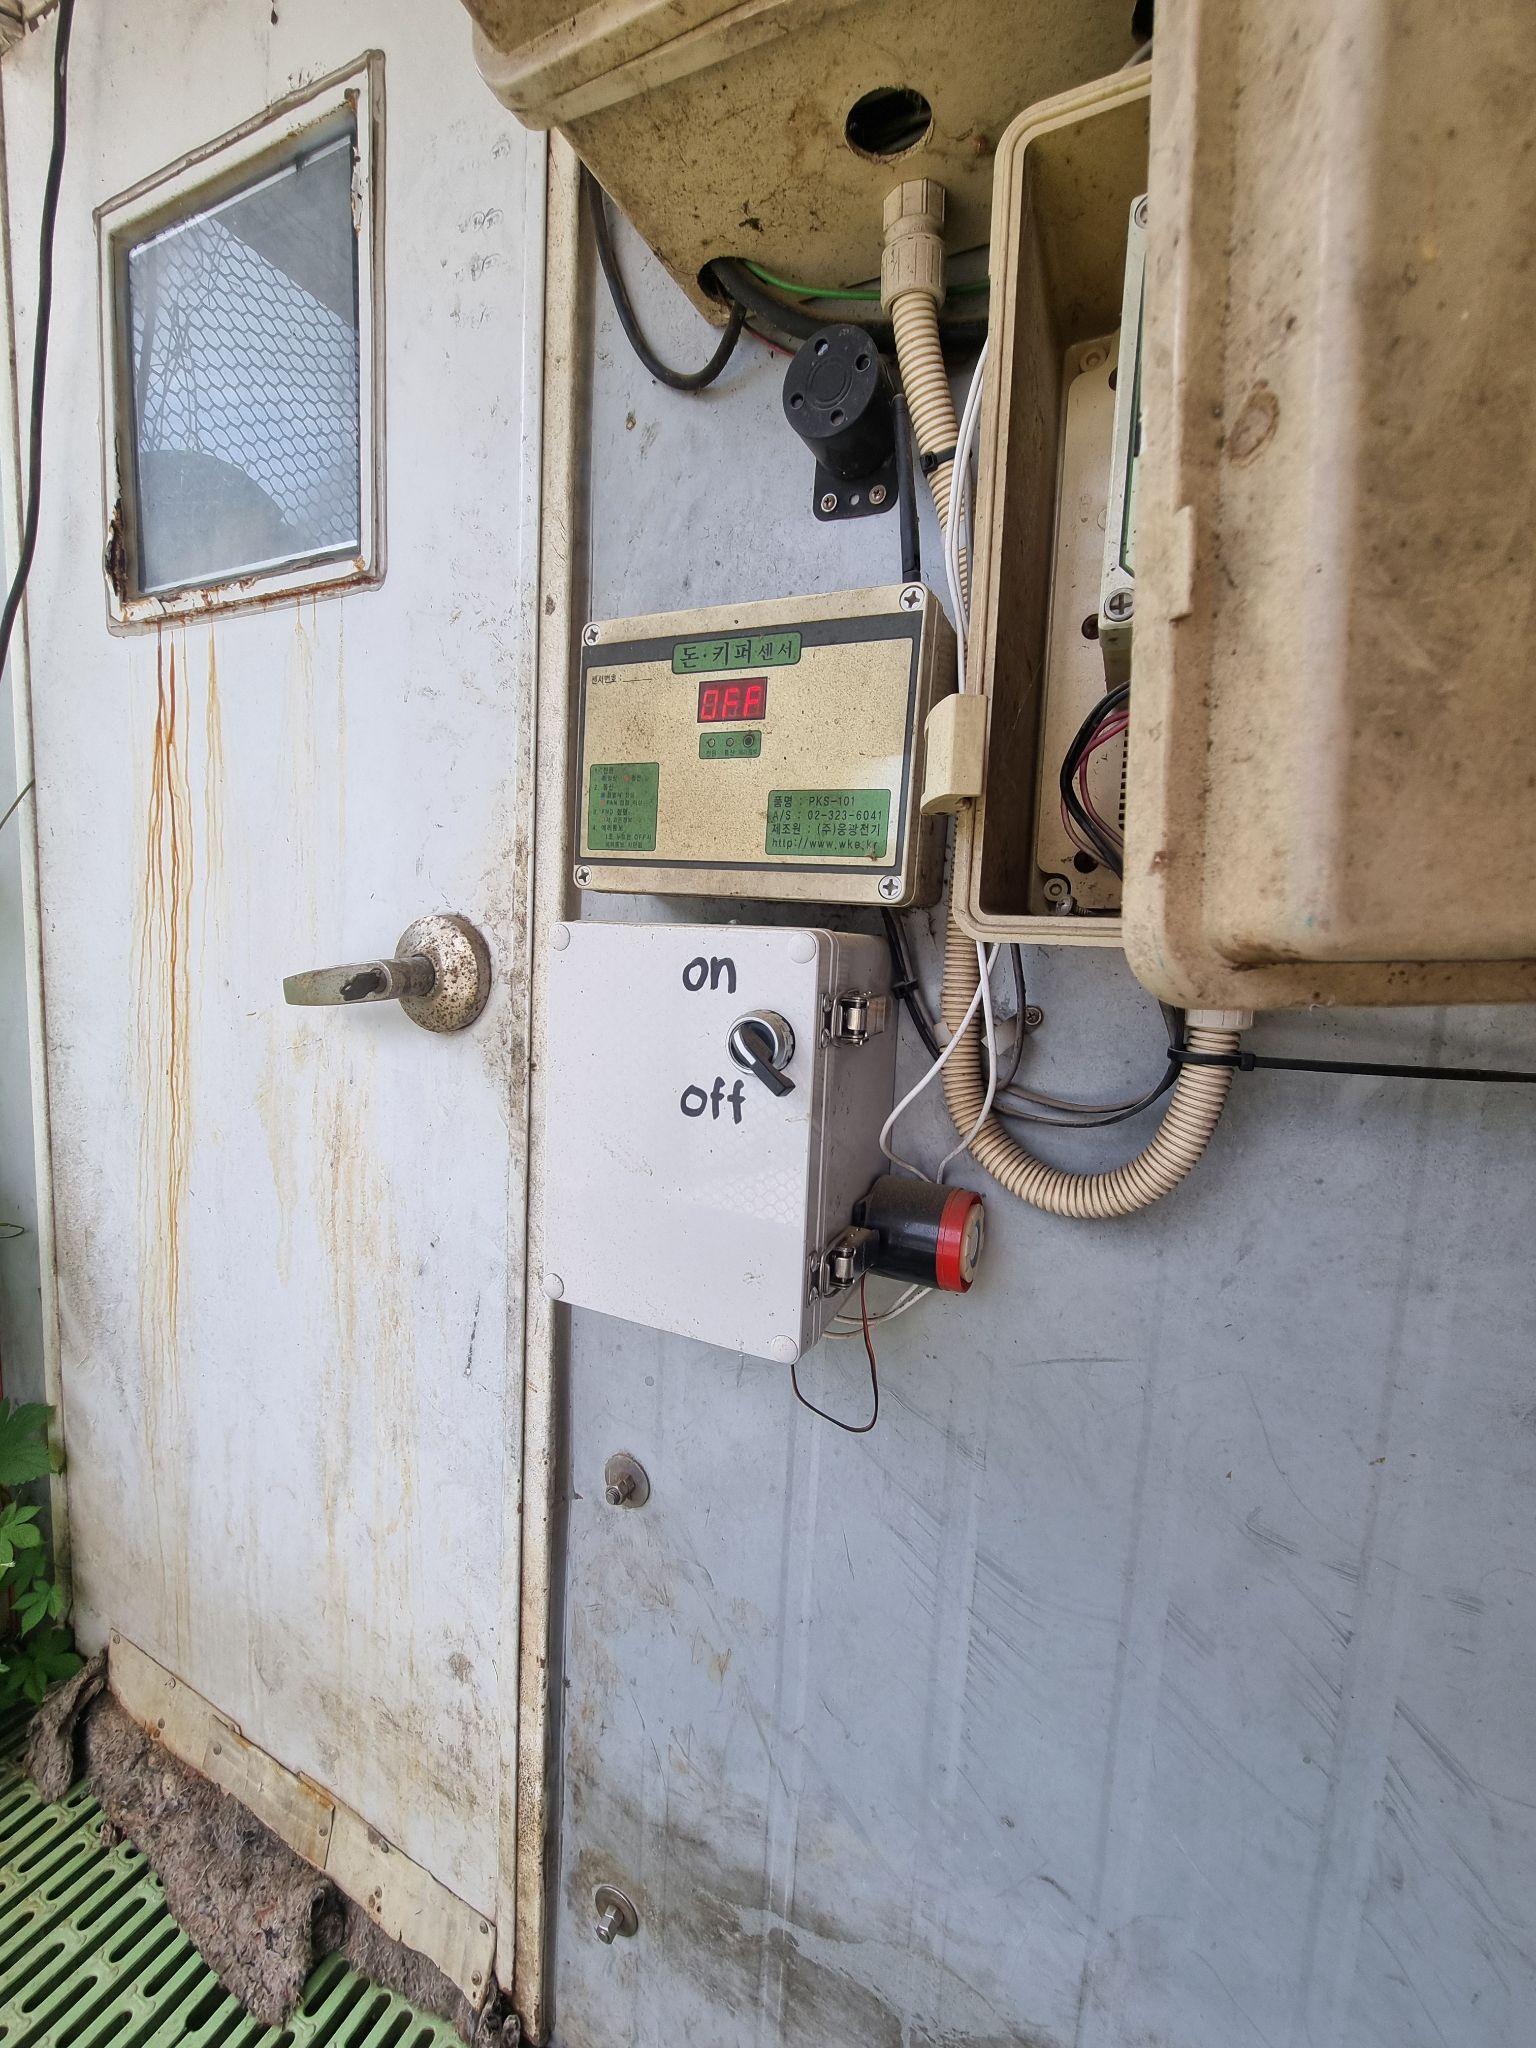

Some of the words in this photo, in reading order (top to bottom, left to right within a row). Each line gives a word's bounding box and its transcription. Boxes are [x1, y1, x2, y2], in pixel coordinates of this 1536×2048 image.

[701, 685, 761, 720] OFF
[773, 795, 793, 808] 품명
[808, 795, 855, 807] PKS-101
[772, 810, 791, 821] A/S
[807, 810, 882, 821] 02-323-6041
[771, 822, 801, 836] 제조원
[682, 956, 737, 994] on
[680, 1076, 746, 1125] off
